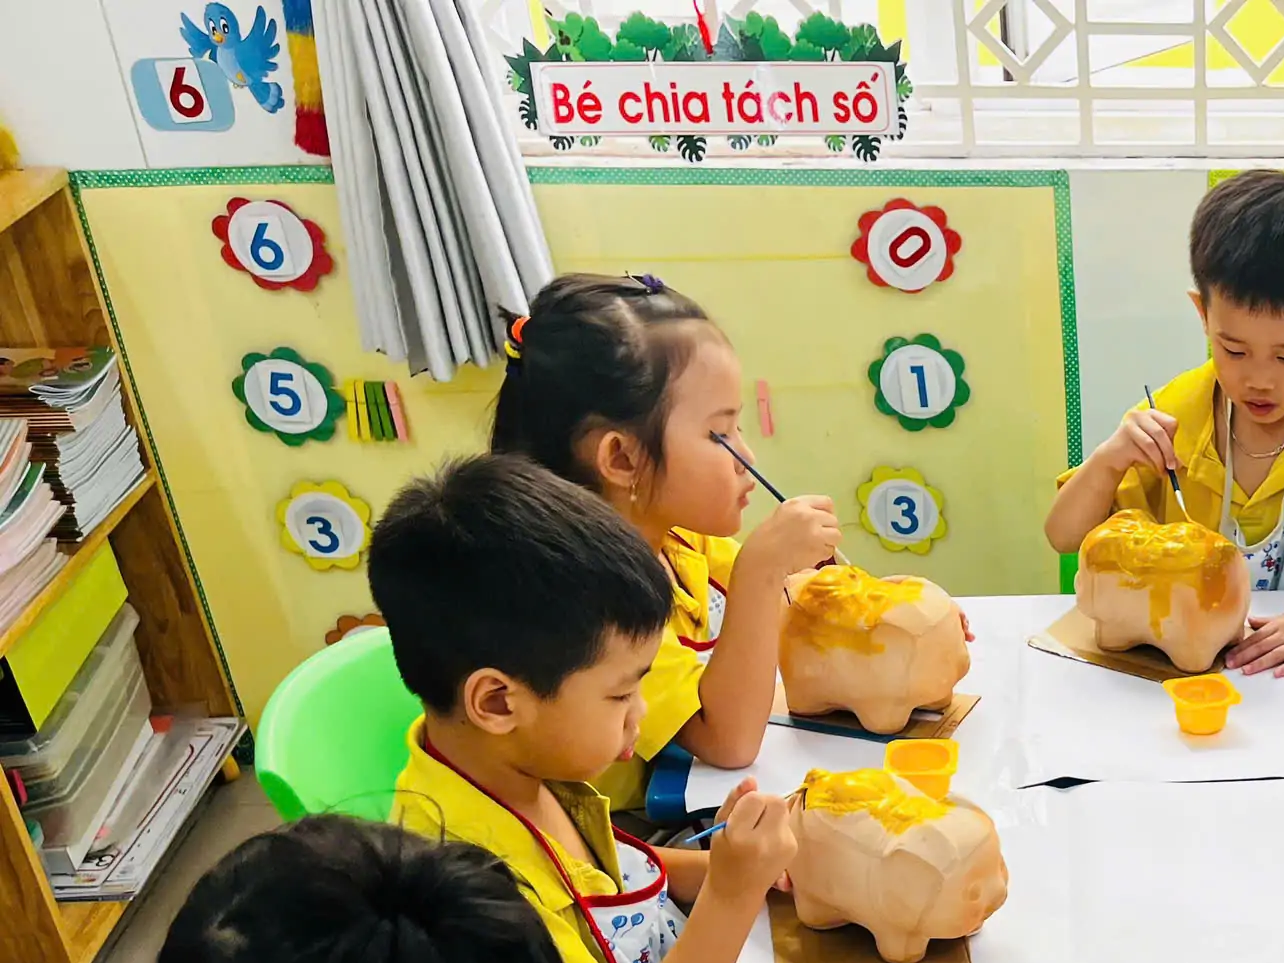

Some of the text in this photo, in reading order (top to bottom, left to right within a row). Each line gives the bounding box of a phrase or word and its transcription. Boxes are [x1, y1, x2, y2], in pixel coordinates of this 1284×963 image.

[169, 66, 204, 118] 6
[552, 71, 879, 125] Bé chia tách số
[250, 222, 284, 271] 6
[268, 371, 302, 416] 5
[909, 365, 929, 408] 1
[306, 516, 340, 554] 3
[890, 495, 919, 535] 3
